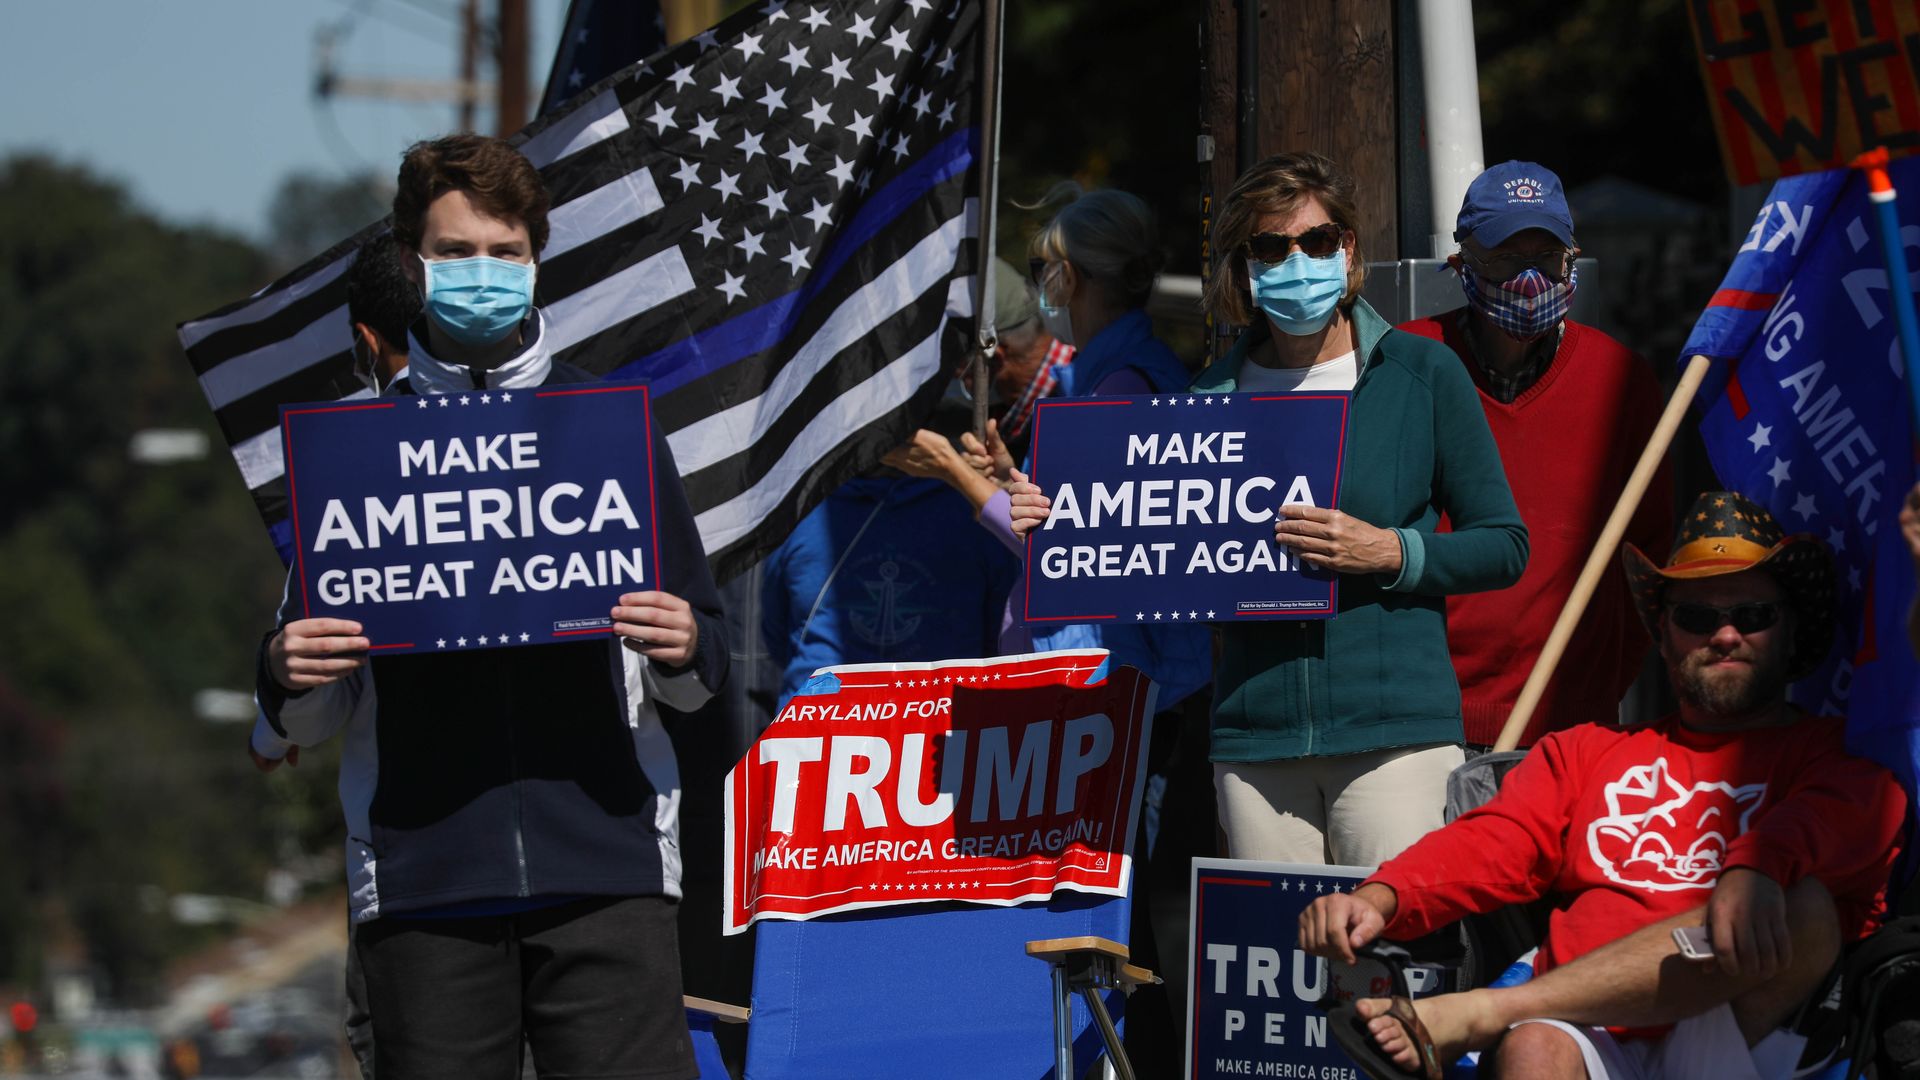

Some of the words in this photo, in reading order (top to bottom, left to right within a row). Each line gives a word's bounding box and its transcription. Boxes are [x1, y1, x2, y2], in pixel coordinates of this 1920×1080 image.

[1724, 33, 1920, 161] WE
[1503, 177, 1543, 191] DEPAUL
[399, 431, 540, 478] MAKE
[1126, 431, 1246, 466] MAKE
[1779, 360, 1887, 536] AMER
[312, 479, 640, 552] AMERICA
[1043, 475, 1317, 530] AMERICA
[317, 560, 474, 606] GREAT
[489, 547, 644, 595] AGAIN
[1040, 542, 1176, 579] GREAT
[903, 697, 952, 719] FOR
[759, 713, 1115, 834] TRUMP
[753, 845, 818, 874] MAKE
[822, 838, 934, 868] AMERICA
[941, 833, 1025, 860] GREAT
[1027, 817, 1103, 852] AGAIN!
[1206, 943, 1438, 1002] TRUP
[1224, 1009, 1327, 1048] PEN
[1216, 1058, 1252, 1074] MAKE
[1255, 1061, 1316, 1080] AMERICA
[1321, 1066, 1357, 1080] GREA
